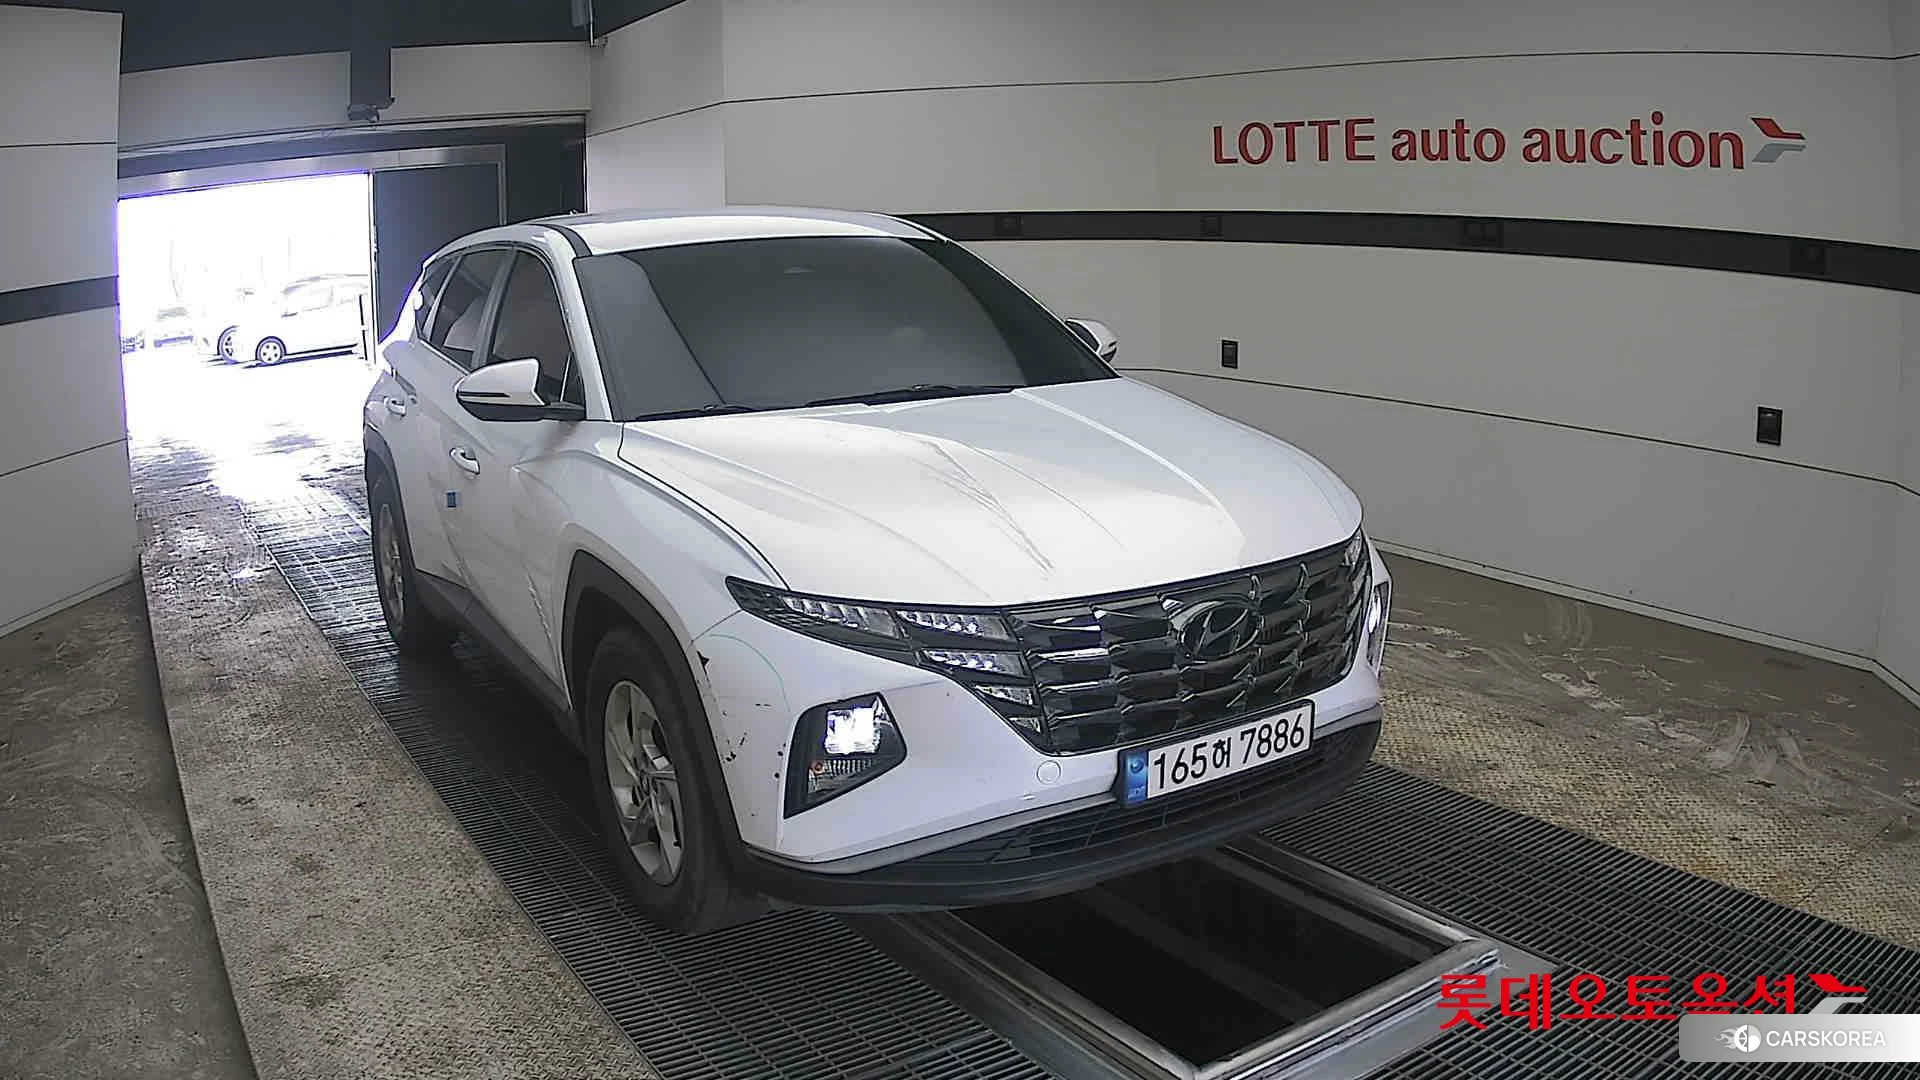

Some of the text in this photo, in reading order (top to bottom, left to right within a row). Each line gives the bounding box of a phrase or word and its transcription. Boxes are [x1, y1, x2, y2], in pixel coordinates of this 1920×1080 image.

[1213, 111, 1745, 170] LOTTE auto auction
[1153, 713, 1305, 789] 165허 7886
